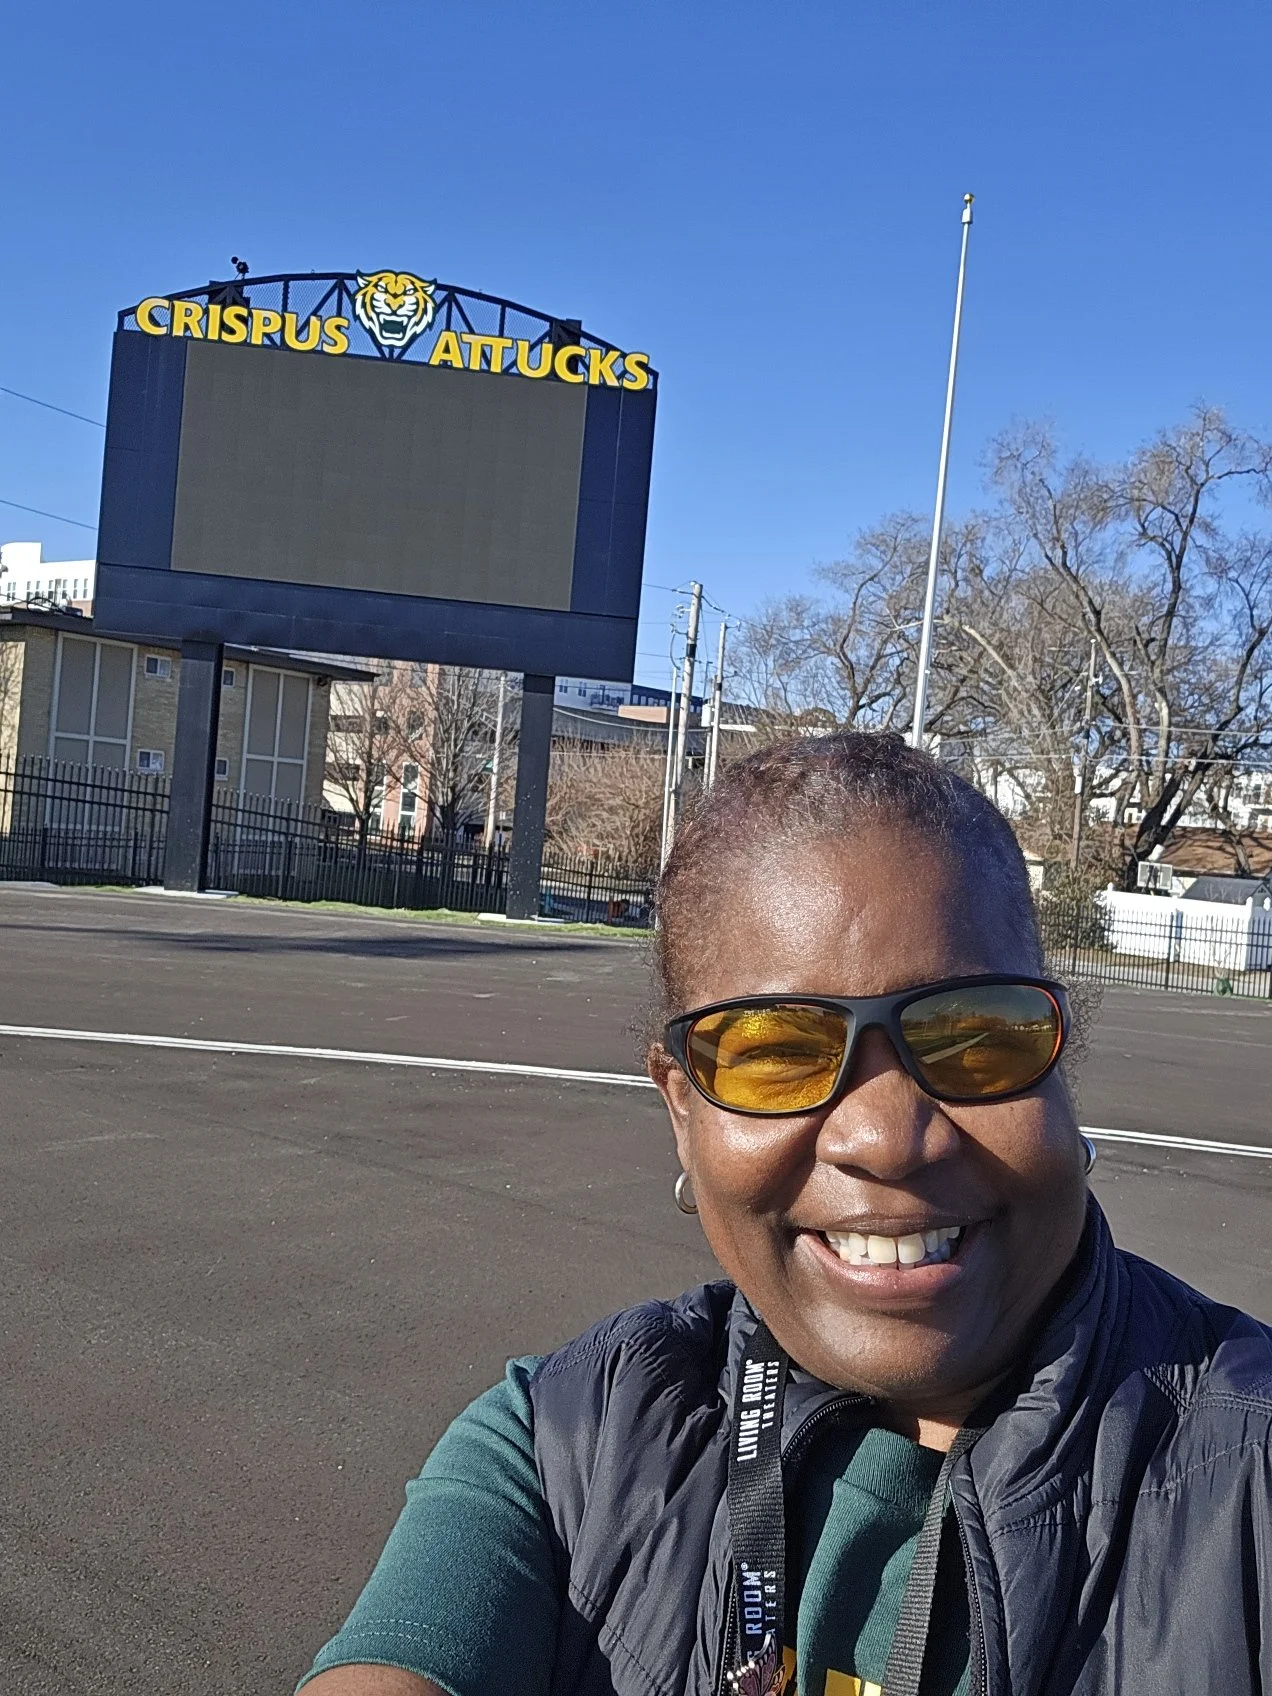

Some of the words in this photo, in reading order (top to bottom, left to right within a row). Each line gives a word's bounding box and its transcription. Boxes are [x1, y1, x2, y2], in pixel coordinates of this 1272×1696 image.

[135, 297, 350, 355] CRISPUS
[428, 330, 650, 391] ATTUCKS
[761, 1361, 780, 1430] THEATERS
[737, 1408, 760, 1462] LIVING
[763, 1570, 777, 1635] ATERS
